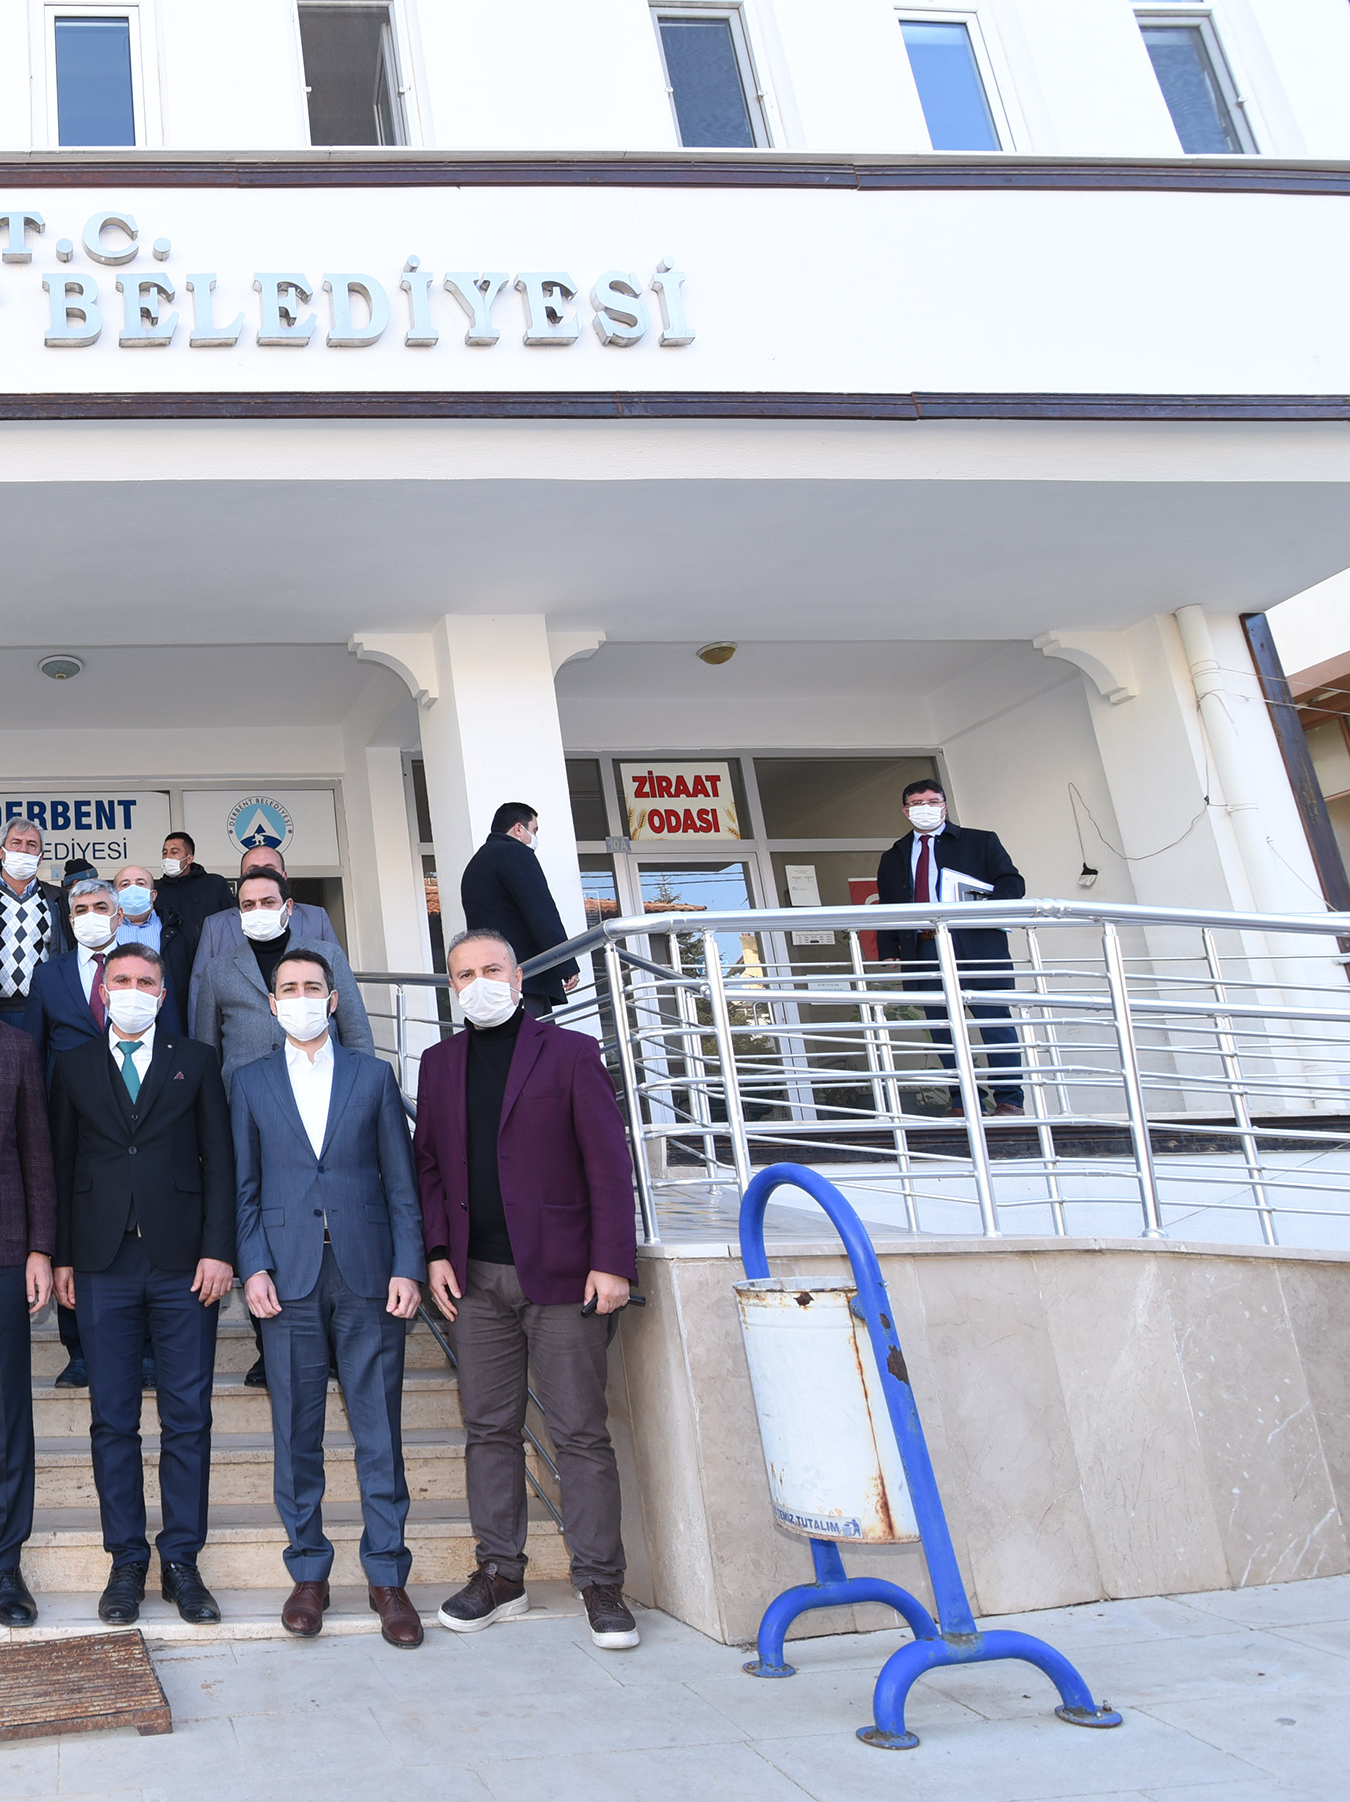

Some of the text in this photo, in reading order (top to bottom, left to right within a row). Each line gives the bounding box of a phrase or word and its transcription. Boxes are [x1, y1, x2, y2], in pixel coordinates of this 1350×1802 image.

[41, 254, 696, 348] BELEDİYESİ
[632, 770, 721, 798] ZİRAAT
[229, 799, 254, 827] DERBENT
[648, 808, 720, 834] ODASI
[796, 1515, 841, 1533] TUTALIM
